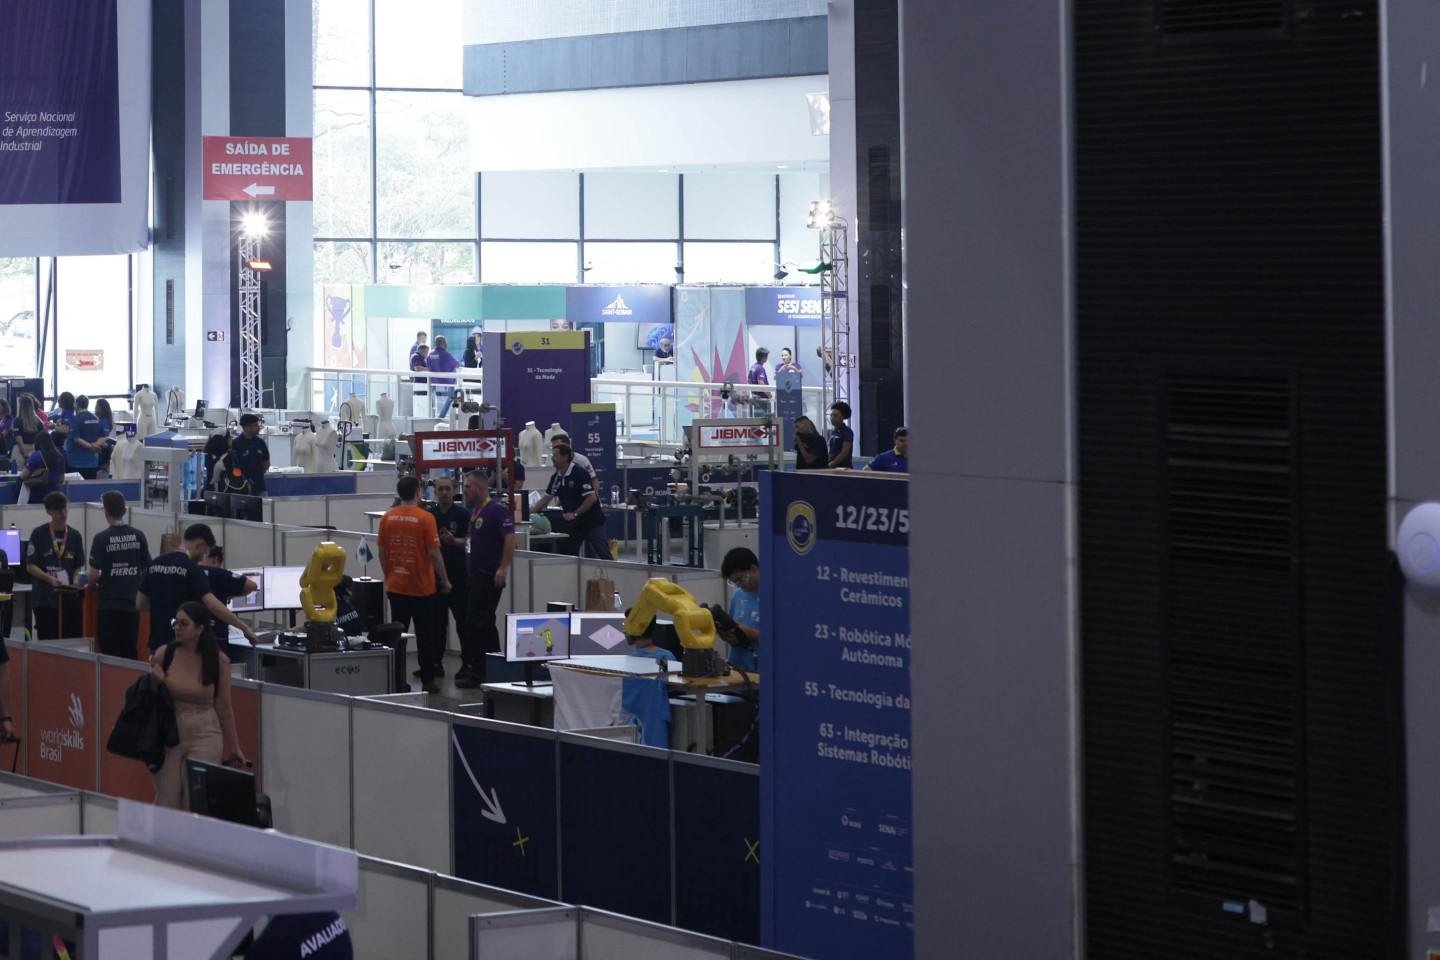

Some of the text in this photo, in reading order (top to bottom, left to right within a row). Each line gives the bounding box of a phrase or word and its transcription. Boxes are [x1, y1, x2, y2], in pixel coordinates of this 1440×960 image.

[4, 111, 75, 123] Serviço Nacional
[2, 126, 77, 139] de Aprendizagem
[0, 141, 42, 151] Industrial
[226, 141, 290, 155] SAÍDA DE
[212, 162, 303, 175] EMERGÊNCIA
[777, 299, 800, 314] SESI
[588, 432, 601, 444] 55
[816, 566, 830, 581] 12
[840, 568, 910, 588] Revestimen
[840, 587, 903, 608] Cerâmicos
[814, 624, 829, 639] 23
[839, 627, 892, 647] Robótica
[841, 647, 903, 668] Autônoma
[805, 681, 819, 696] 55
[828, 684, 893, 709] Tecnologia
[895, 693, 910, 709] da
[40, 728, 84, 750] worldskills
[819, 723, 834, 738] 63
[844, 726, 909, 750] Integração
[40, 742, 62, 761] Brasil
[817, 742, 912, 770] Sistemas Robóti
